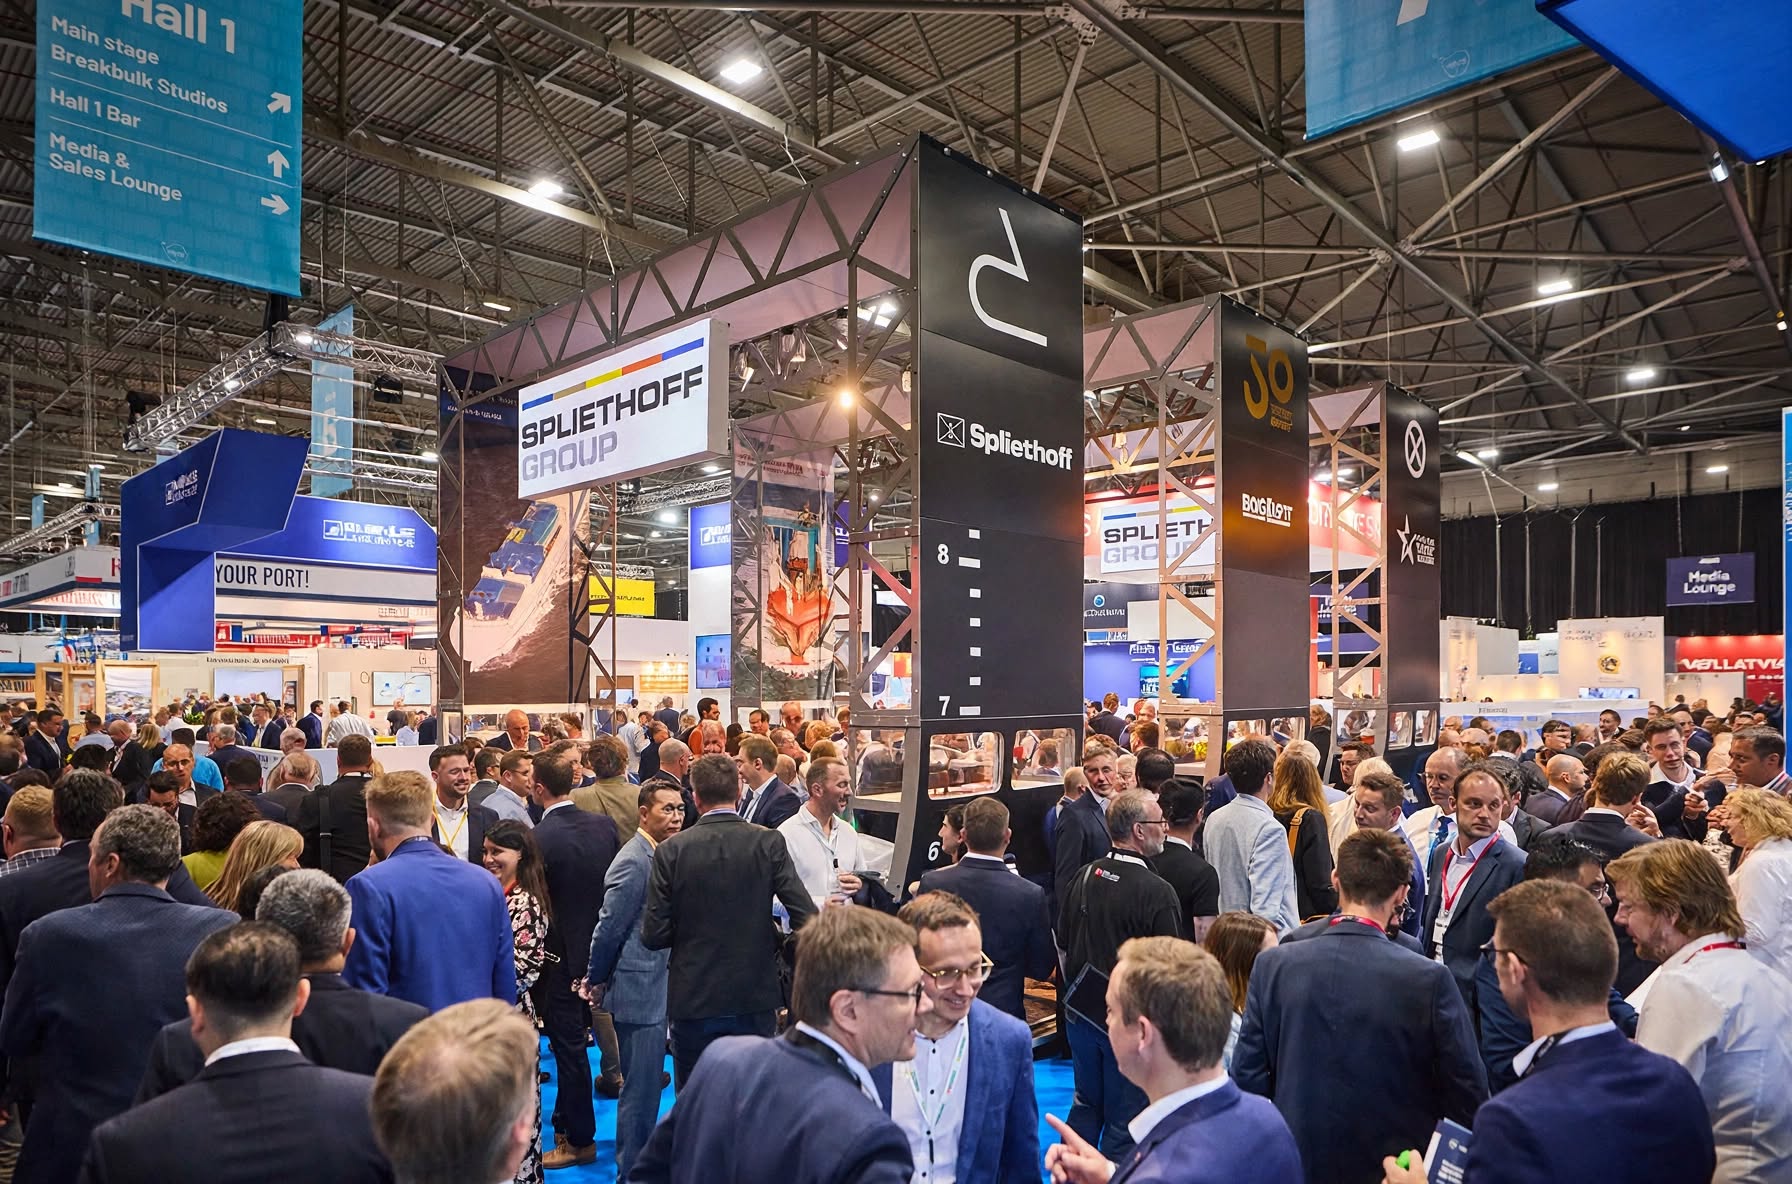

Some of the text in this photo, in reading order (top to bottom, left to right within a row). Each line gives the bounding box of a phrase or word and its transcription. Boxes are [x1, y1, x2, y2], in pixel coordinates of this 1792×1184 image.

[52, 16, 160, 64] Main stage
[220, 18, 236, 54] 1
[51, 44, 229, 113] Breakbulk Studios
[51, 87, 141, 128] Hall 1 Bar
[50, 132, 130, 169] Media &
[50, 153, 182, 201] Sales Lounge
[522, 364, 703, 449] SPLIETHOFF
[522, 430, 618, 481] GROUP
[970, 423, 1073, 470] Spliethoff
[936, 543, 949, 566] 8
[216, 563, 309, 588] YOUR PORT!
[1683, 583, 1736, 596] Lounge
[1688, 570, 1730, 583] Media
[939, 695, 950, 716] 7
[927, 841, 941, 861] 6
